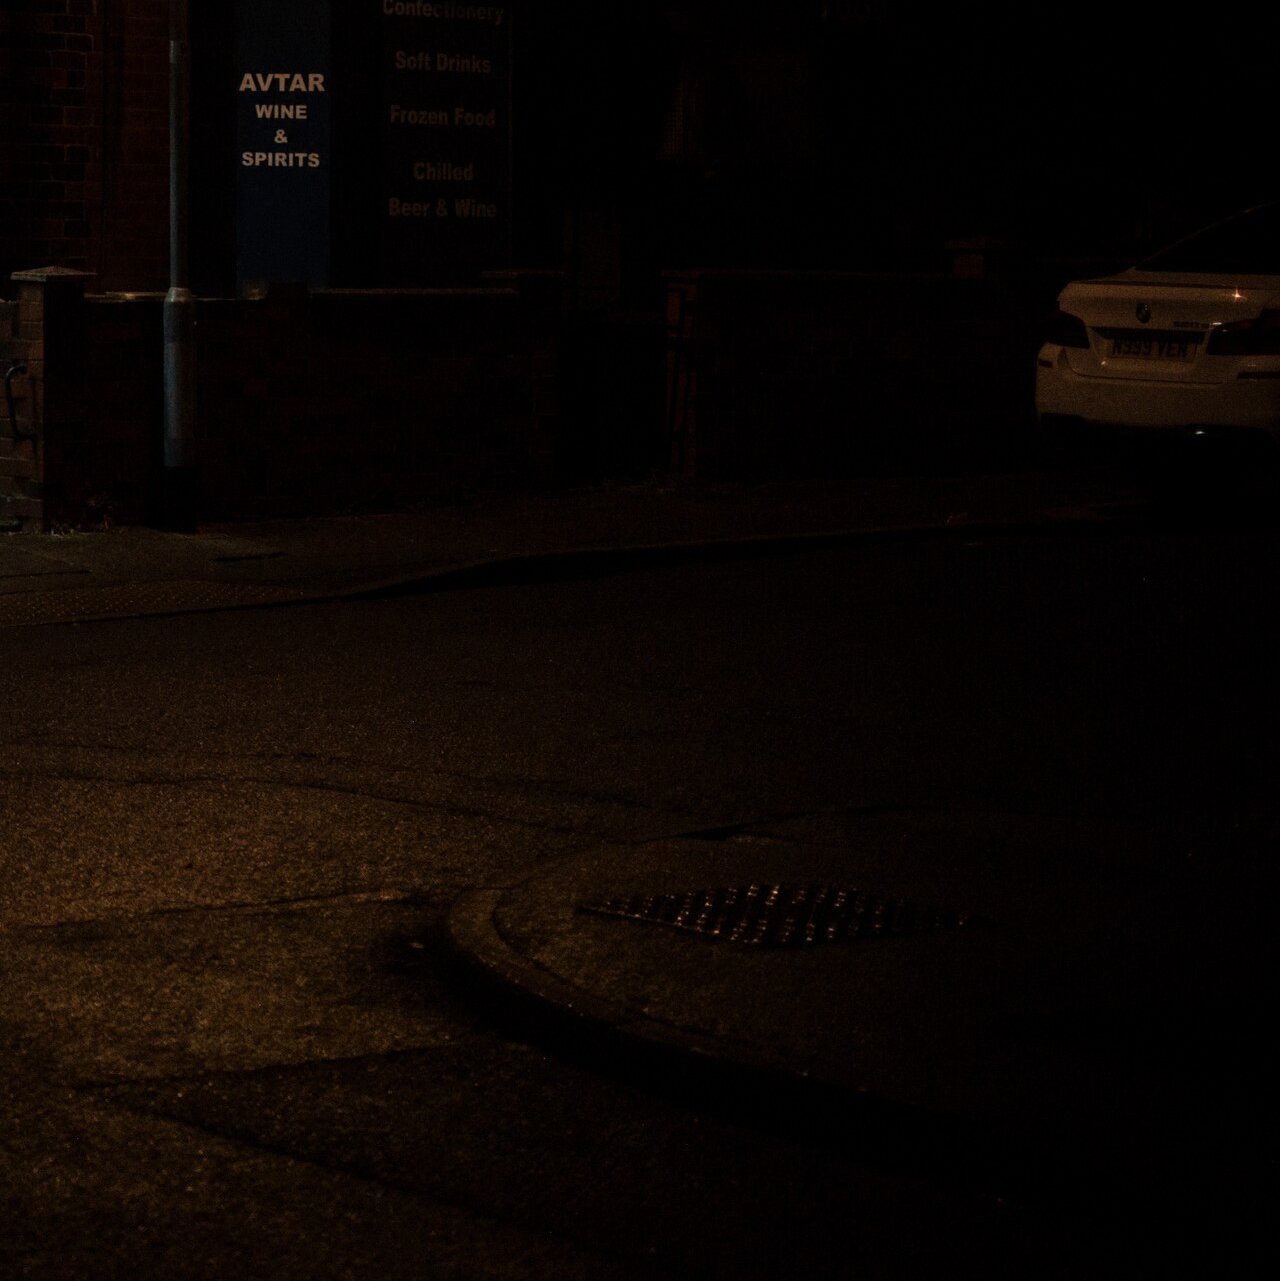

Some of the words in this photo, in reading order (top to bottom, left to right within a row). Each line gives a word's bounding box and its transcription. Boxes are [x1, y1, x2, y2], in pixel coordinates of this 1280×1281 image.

[395, 50, 432, 71] Soft
[436, 52, 492, 74] Drinks
[239, 72, 326, 92] AVTAR
[255, 104, 308, 119] WINE
[390, 105, 449, 126] Frozen
[454, 107, 496, 127] Food
[274, 129, 289, 144] &
[241, 151, 321, 168] SPIRITS
[413, 161, 473, 181] Chilled
[388, 197, 431, 218] Beer
[435, 198, 449, 218] &
[455, 198, 498, 218] Wine
